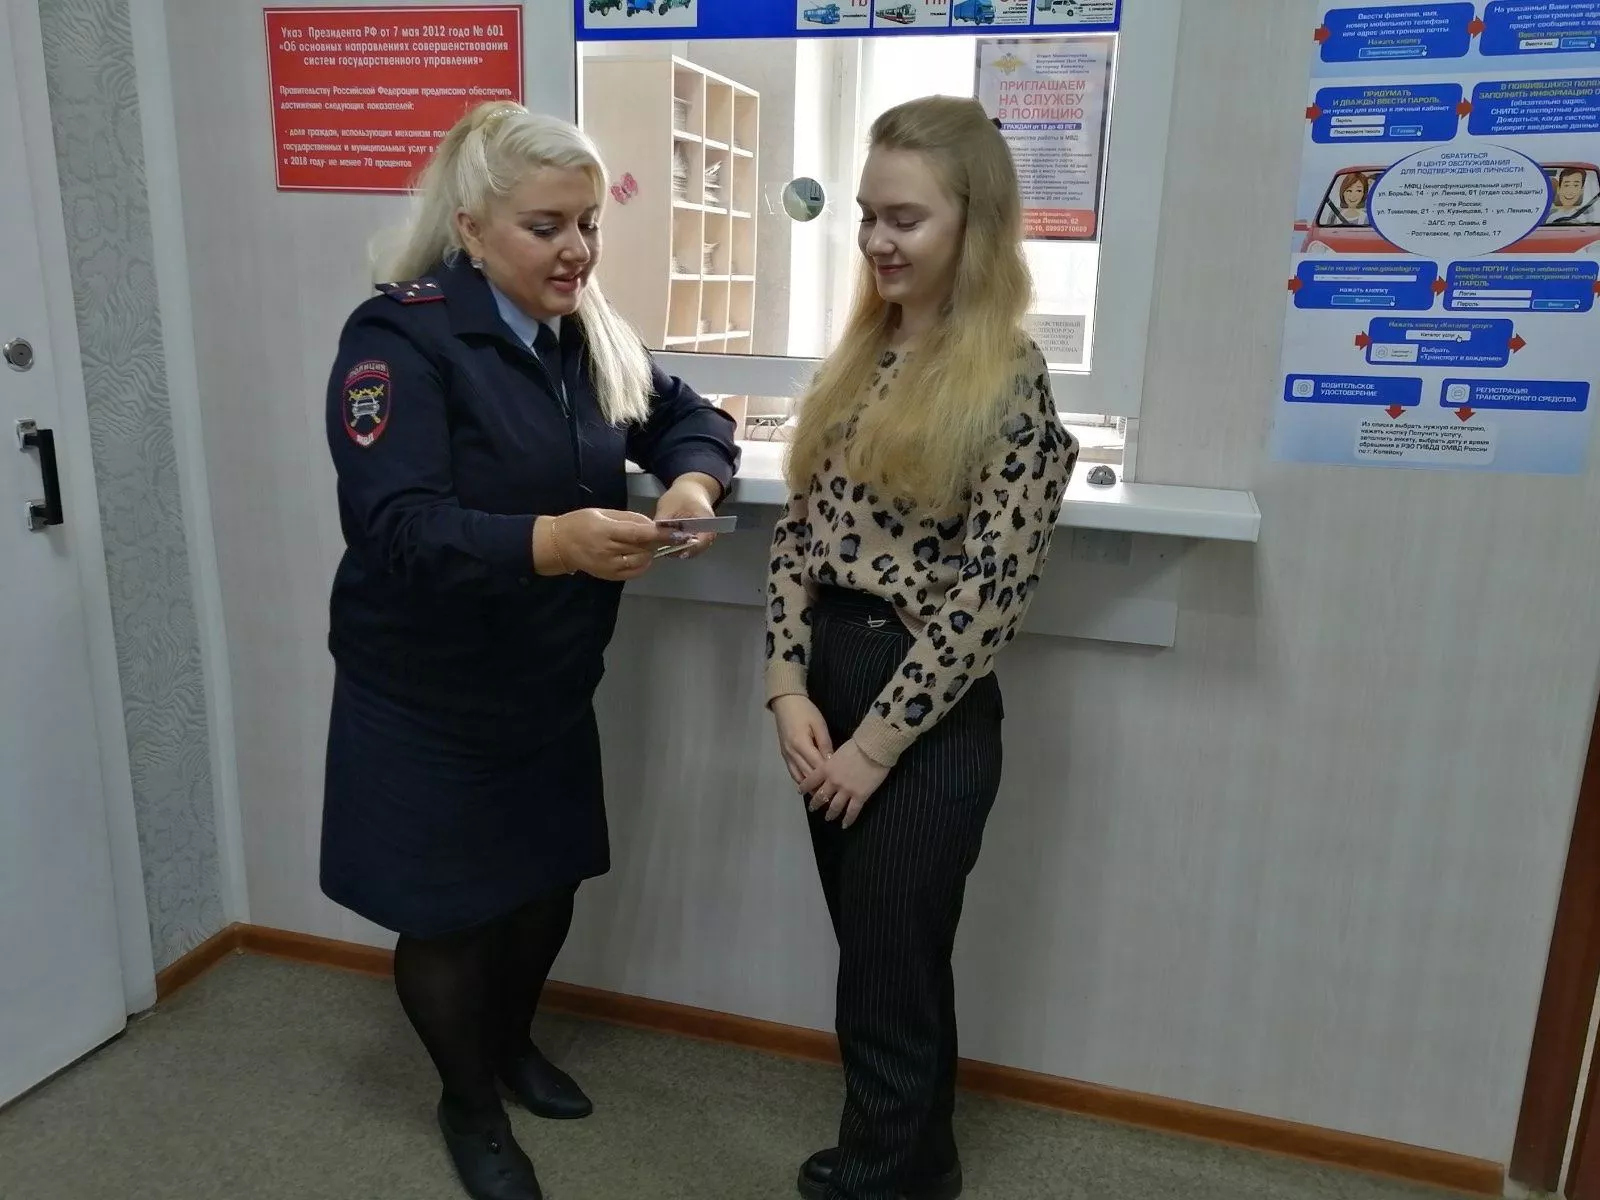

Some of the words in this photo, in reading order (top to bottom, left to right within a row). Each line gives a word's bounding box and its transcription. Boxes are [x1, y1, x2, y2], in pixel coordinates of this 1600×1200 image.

[1345, 22, 1369, 30] номер
[1369, 20, 1412, 28] мобильного
[1413, 18, 1450, 26] телефона
[281, 26, 303, 38] Указ
[308, 26, 361, 40] Президента
[364, 25, 377, 37] РФ
[380, 28, 390, 37] от
[393, 26, 398, 37] 7
[402, 28, 420, 37] мая
[423, 25, 446, 37] 2012
[449, 27, 470, 38] года
[472, 25, 484, 37] №
[487, 24, 504, 37] 601
[279, 40, 296, 52] «Об
[299, 42, 342, 52] основных
[345, 42, 410, 54] направлениях
[412, 42, 508, 54] совершенствования
[303, 56, 336, 66] систем
[338, 56, 421, 68] государственного
[423, 56, 484, 68] управления»
[1000, 80, 1086, 91] ПРИГЛАШАЕМ
[279, 85, 331, 97] Правительству
[332, 85, 376, 95] Российской
[377, 85, 419, 97] Федерации
[421, 87, 467, 97] предписано
[468, 86, 512, 97] обеспечить
[1363, 89, 1412, 97] ПРИДУМАТЬ
[1479, 91, 1528, 100] ЗАПОЛНИТЬ
[1529, 88, 1593, 97] ИНФОРМАЦИЮ
[999, 94, 1019, 105] НА
[1023, 93, 1085, 106] СЛУЖБУ
[1339, 98, 1376, 107] ДВАЖДЫ
[1376, 97, 1408, 105] ВВЕСТИ
[324, 102, 365, 112] следующих
[1333, 107, 1354, 115] нужен
[1367, 106, 1388, 114] входа
[1394, 105, 1421, 113] личный
[1526, 107, 1572, 115] паспортные
[998, 109, 1007, 119] В
[1012, 107, 1084, 121] ПОЛИЦИЮ
[1491, 124, 1526, 132] проверит
[289, 128, 306, 137] доля
[307, 129, 340, 138] граждан,
[341, 129, 393, 139] использующих
[395, 130, 431, 138] механизм
[282, 143, 342, 153] государственных
[351, 144, 406, 154] муниципальных
[408, 145, 427, 155] услуг
[1440, 152, 1488, 160] ОБРАТИТЬСЯ
[290, 156, 308, 166] 2018
[340, 159, 362, 167] менее
[363, 157, 373, 167] 70
[375, 160, 412, 169] процентов
[1423, 160, 1447, 168] ЦЕНТР
[1448, 159, 1511, 167] ОБСЛУЖИВАНИЯ
[1417, 167, 1482, 175] ПОДТВЕРЖДЕНИЯ
[1500, 181, 1523, 189] центр)
[1441, 189, 1467, 197] Ленина,
[1478, 189, 1500, 197] (отдел
[1420, 353, 1459, 361] «Транспорт
[1321, 382, 1375, 390] ВОДИТЕЛЬСКОЕ
[1320, 388, 1379, 397] УДОСТОВЕРЕНИЕ
[1475, 387, 1529, 395] РЕГИСТРАЦИЯ
[1475, 393, 1537, 402] ТРАНСПОРТНОГО
[1538, 395, 1577, 403] СРЕДСТВА
[1408, 429, 1439, 437] Получить
[1449, 425, 1486, 433] категорию,
[1416, 443, 1440, 451] ГИБДД
[1441, 444, 1463, 452] ОМВД
[1373, 448, 1403, 457] Копейску
